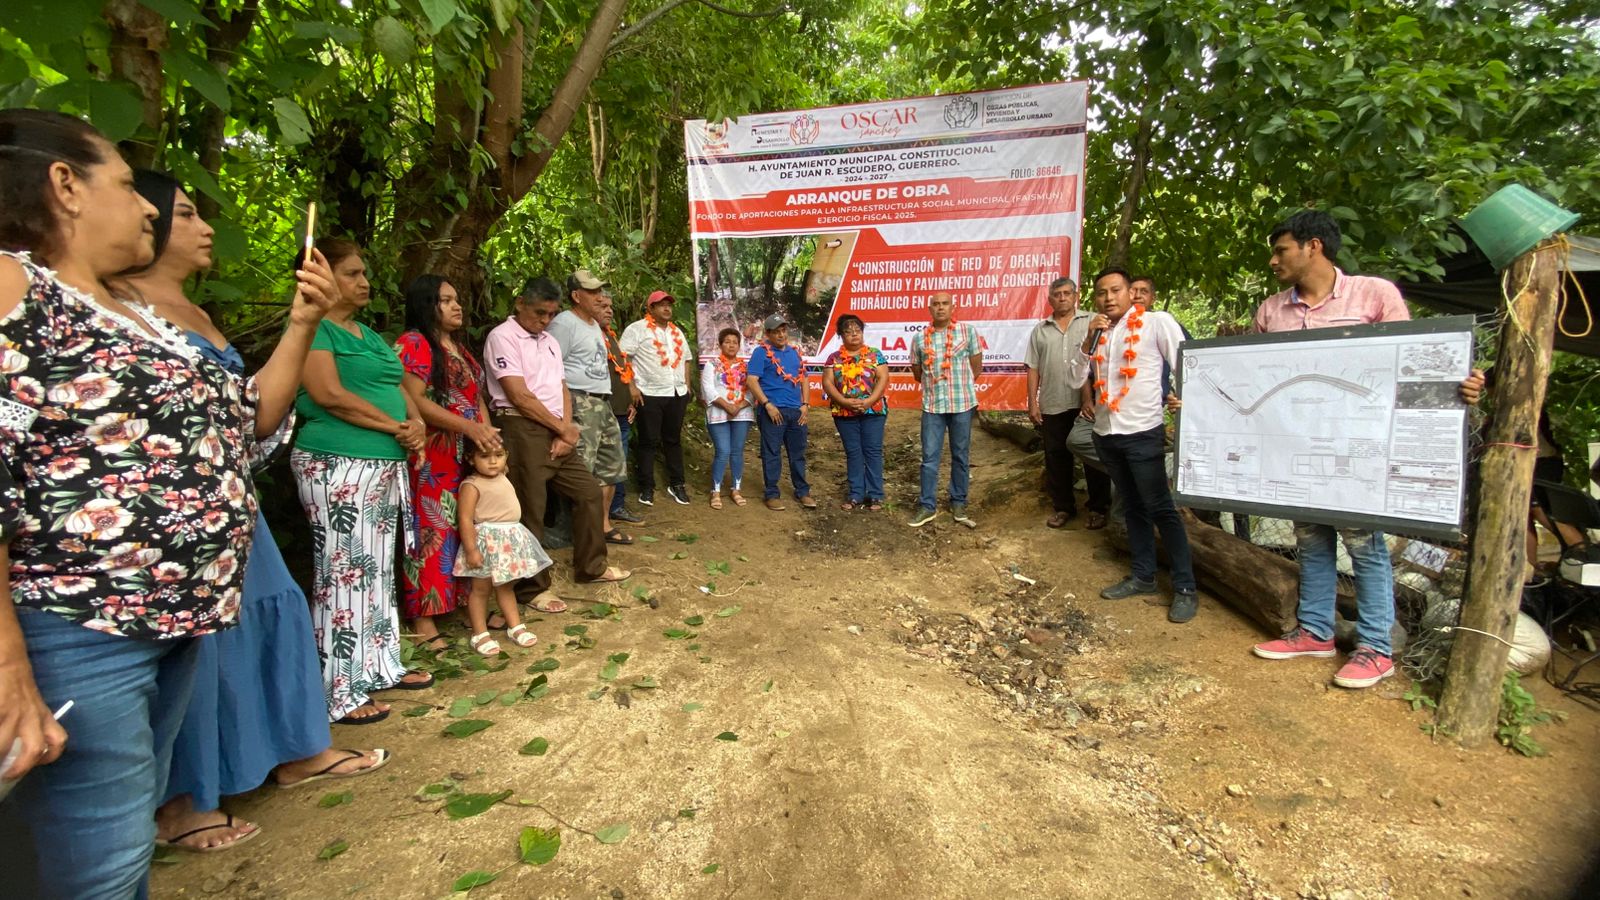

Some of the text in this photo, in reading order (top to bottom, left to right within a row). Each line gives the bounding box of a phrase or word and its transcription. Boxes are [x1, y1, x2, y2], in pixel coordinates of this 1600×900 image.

[840, 106, 918, 129] OSCAR
[986, 112, 1053, 124] DESARROLLO URBANO
[748, 146, 996, 173] H. AYUNTAMIENTO MUNICIPAL CONSTITUCIONAL
[780, 159, 960, 180] DE JUAN R. ESCUDERO, GUERRERO.
[844, 174, 863, 182] 2024
[870, 173, 888, 181] 2027
[1010, 167, 1035, 179] FOLIO:
[787, 184, 950, 206] ARRANQUE DE OBRA
[697, 191, 1064, 221] FONDO DE APORTACIONES PARA LA INFRAESTRUCTURA SOCIAL MUNICIPAL (FAISMUN)
[817, 211, 917, 224] EJERCICIO FISCAL 2025.
[942, 257, 955, 272] DE
[961, 257, 982, 270] RED
[990, 256, 1002, 269] DE
[1011, 252, 1060, 268] DRENAJE
[851, 272, 1059, 293] SANITARIO Y PAVIMENTO CON CONCRETO
[850, 295, 909, 310] HIDRÁULICO
[912, 295, 924, 308] EN
[960, 294, 972, 307] LA
[882, 337, 907, 351] LA
[496, 357, 507, 368] 5
[888, 383, 916, 391] JUAN
